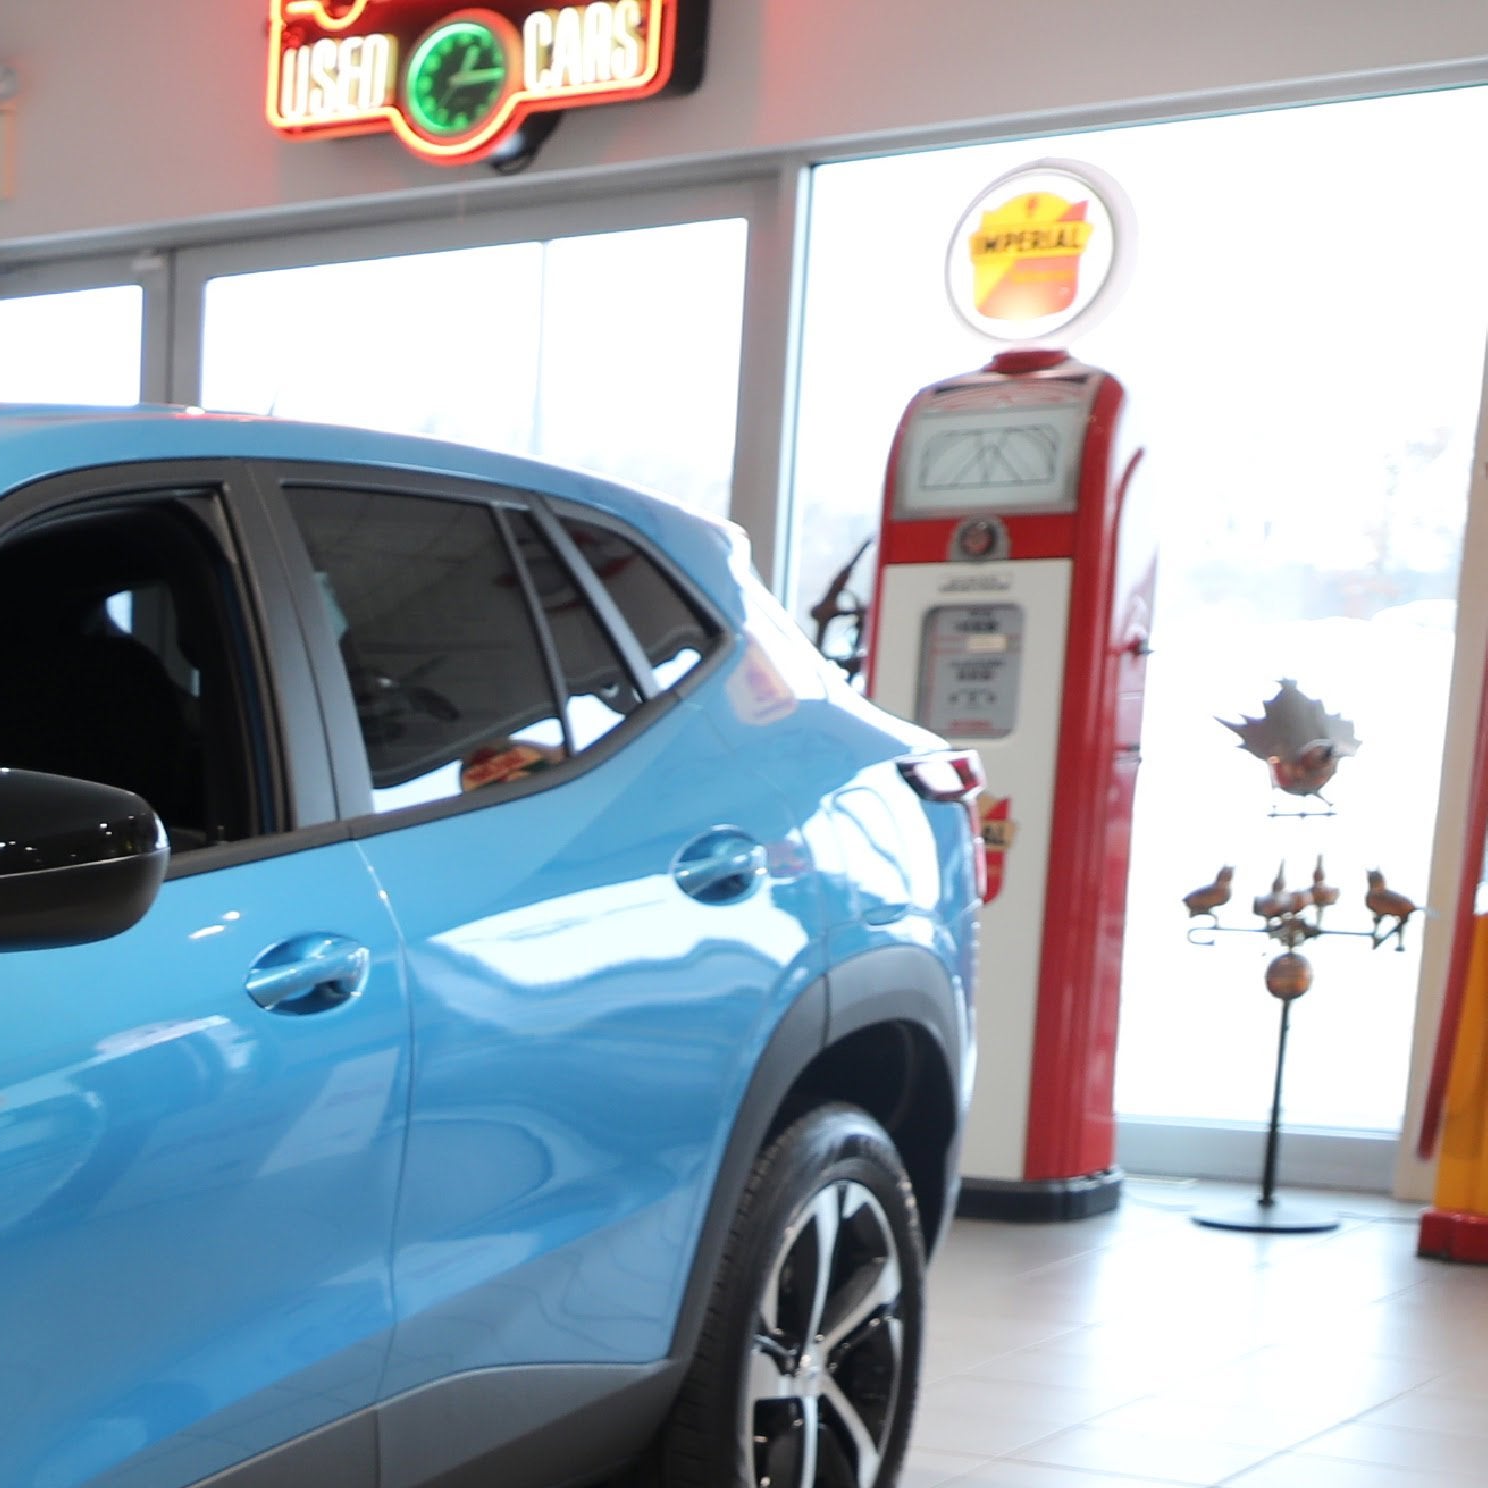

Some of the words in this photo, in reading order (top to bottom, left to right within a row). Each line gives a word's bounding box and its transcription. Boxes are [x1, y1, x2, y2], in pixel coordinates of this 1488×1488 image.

[281, 34, 397, 120] USED
[523, 1, 639, 91] CARS
[975, 227, 1081, 254] IMPERIAL
